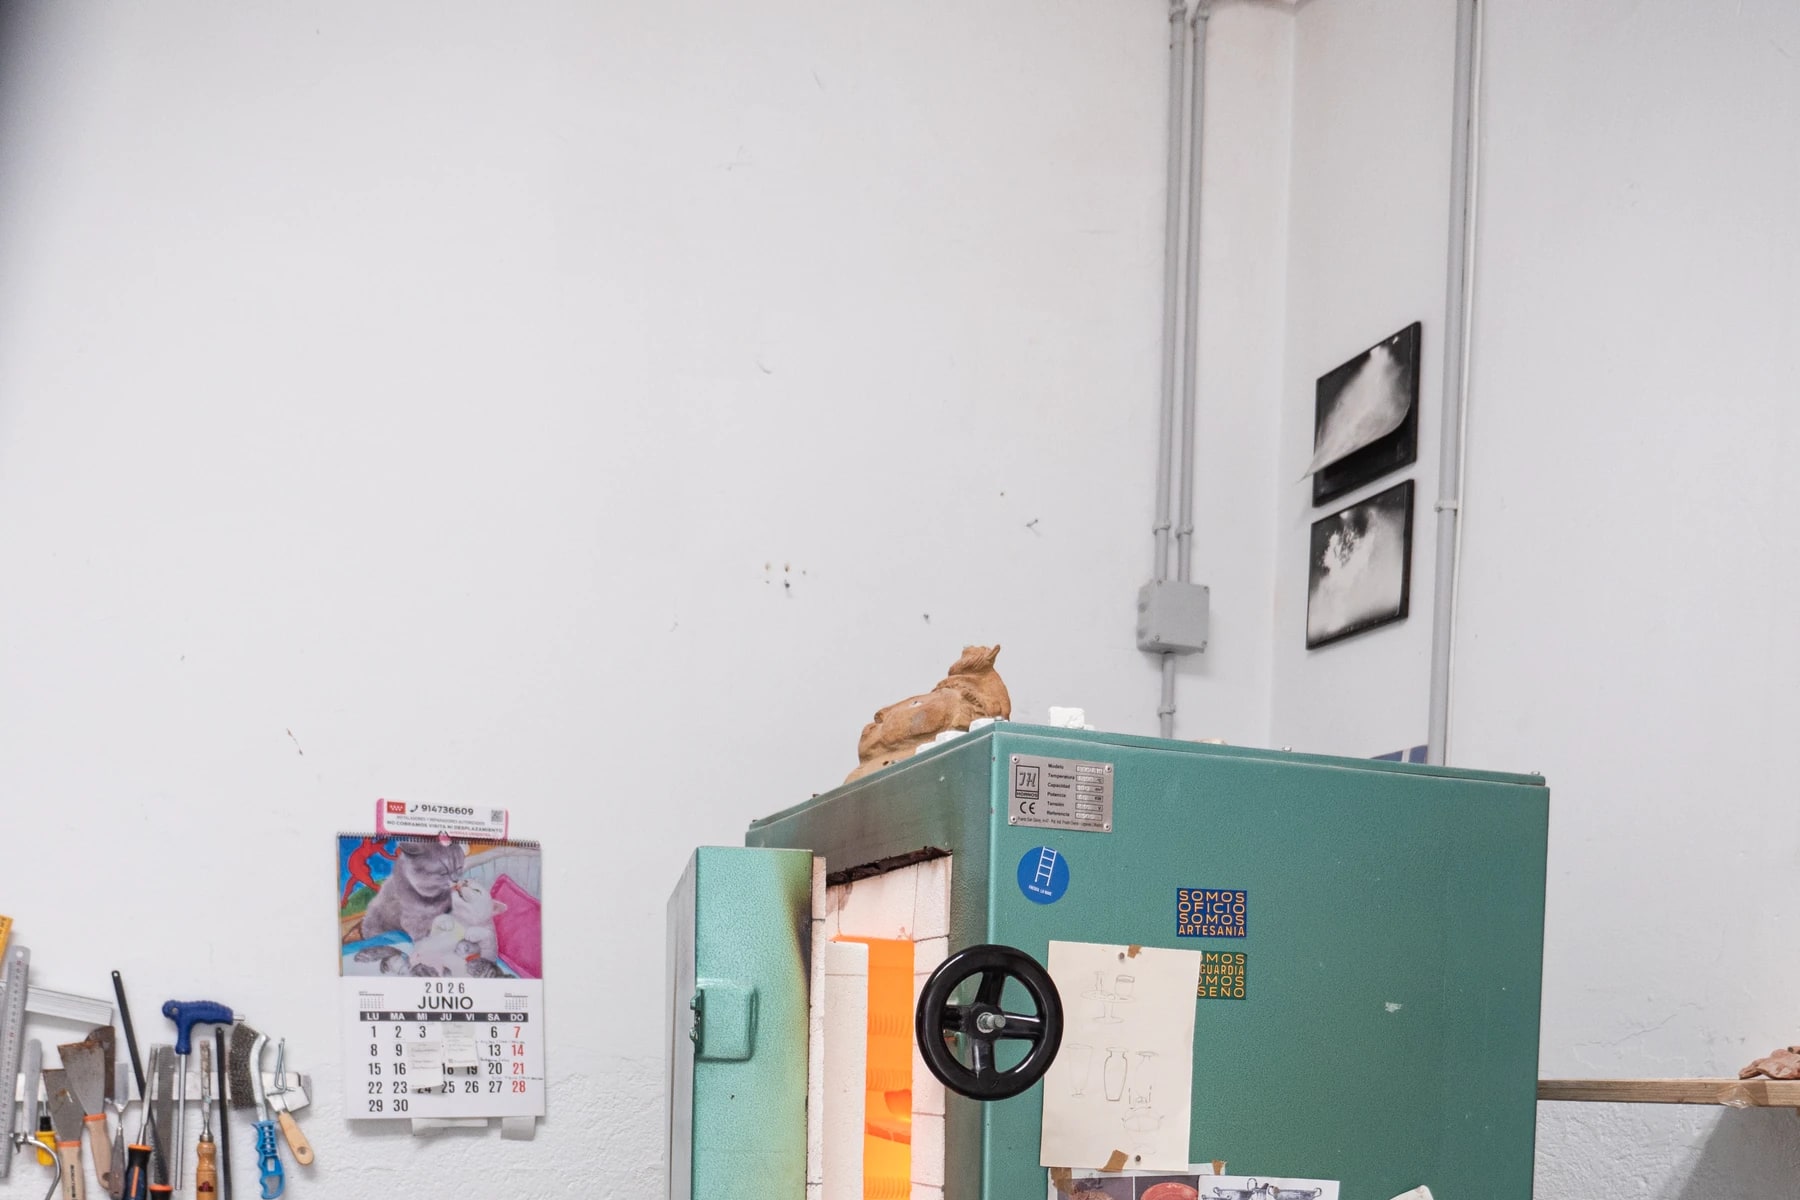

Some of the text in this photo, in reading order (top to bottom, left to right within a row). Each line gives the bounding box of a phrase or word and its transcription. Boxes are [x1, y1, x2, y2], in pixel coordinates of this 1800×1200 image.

[421, 804, 474, 815] 914736609
[1179, 890, 1245, 903] SOMOS
[1178, 902, 1245, 914] OFICIO
[1179, 913, 1245, 925] SOMOS
[1200, 953, 1244, 964] MOS
[1200, 964, 1244, 975] GUARDIA
[1198, 976, 1244, 986] MOS
[426, 983, 465, 993] 2026
[418, 996, 473, 1010] JUNIO
[367, 1013, 524, 1021] LU MA MI JU VI SA DO
[372, 1026, 520, 1038] 1 2 3 6 7
[371, 1044, 523, 1056] 8 9 13 14
[369, 1063, 381, 1075] 15
[394, 1063, 406, 1075] 16
[489, 1063, 502, 1075] 20
[513, 1063, 524, 1074] 21
[368, 1082, 382, 1094] 22
[393, 1081, 407, 1093] 23
[441, 1081, 455, 1093] 25
[465, 1081, 478, 1093] 26
[489, 1081, 502, 1093] 27
[512, 1081, 526, 1093] 28
[369, 1099, 408, 1112] 29 30
